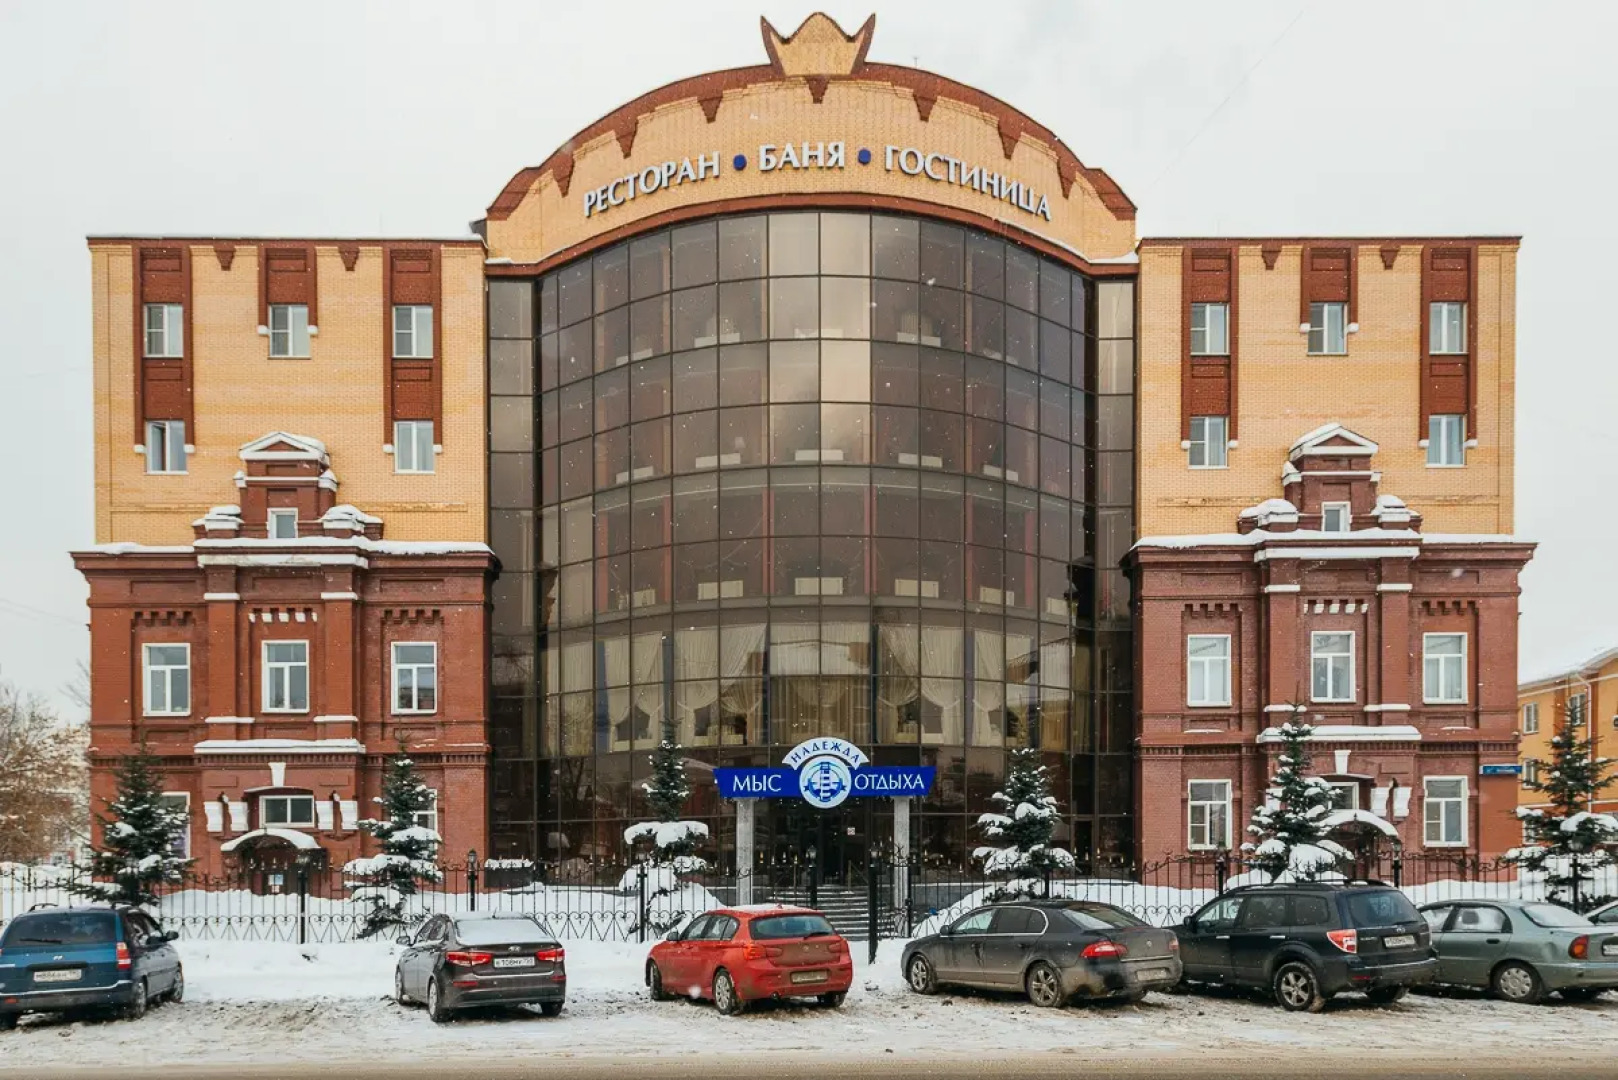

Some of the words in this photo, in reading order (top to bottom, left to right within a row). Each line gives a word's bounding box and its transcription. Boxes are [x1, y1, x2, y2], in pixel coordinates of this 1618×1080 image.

[583, 151, 721, 217] РЕСТОРАН
[758, 141, 845, 171] БАНЯ
[885, 145, 1051, 221] ГОСТИНИЦА
[790, 741, 861, 763] НАДЕЖДА
[733, 774, 782, 792] МЫС
[854, 773, 925, 791] ОТДЫХА
